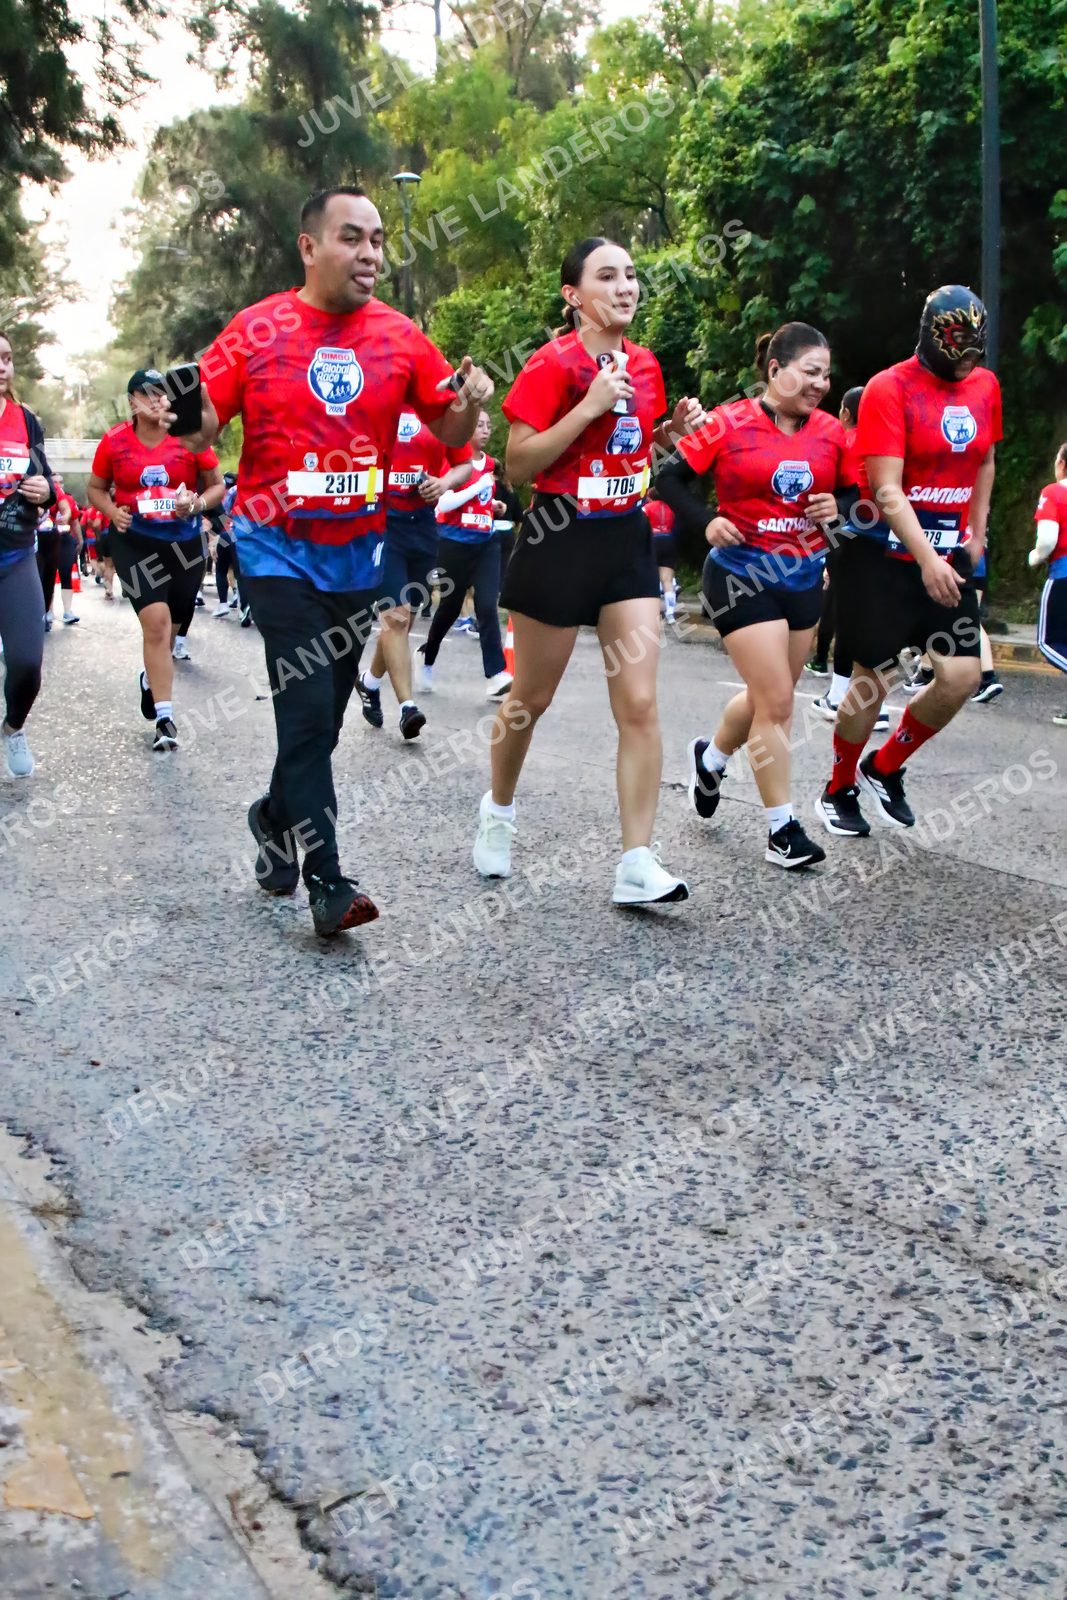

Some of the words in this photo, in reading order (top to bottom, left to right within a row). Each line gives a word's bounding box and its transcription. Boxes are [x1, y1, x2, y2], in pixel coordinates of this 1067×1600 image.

[322, 362, 351, 376] Global
[316, 371, 341, 383] Race
[325, 473, 359, 494] 2311
[394, 473, 416, 484] 3506
[606, 477, 636, 496] 1709
